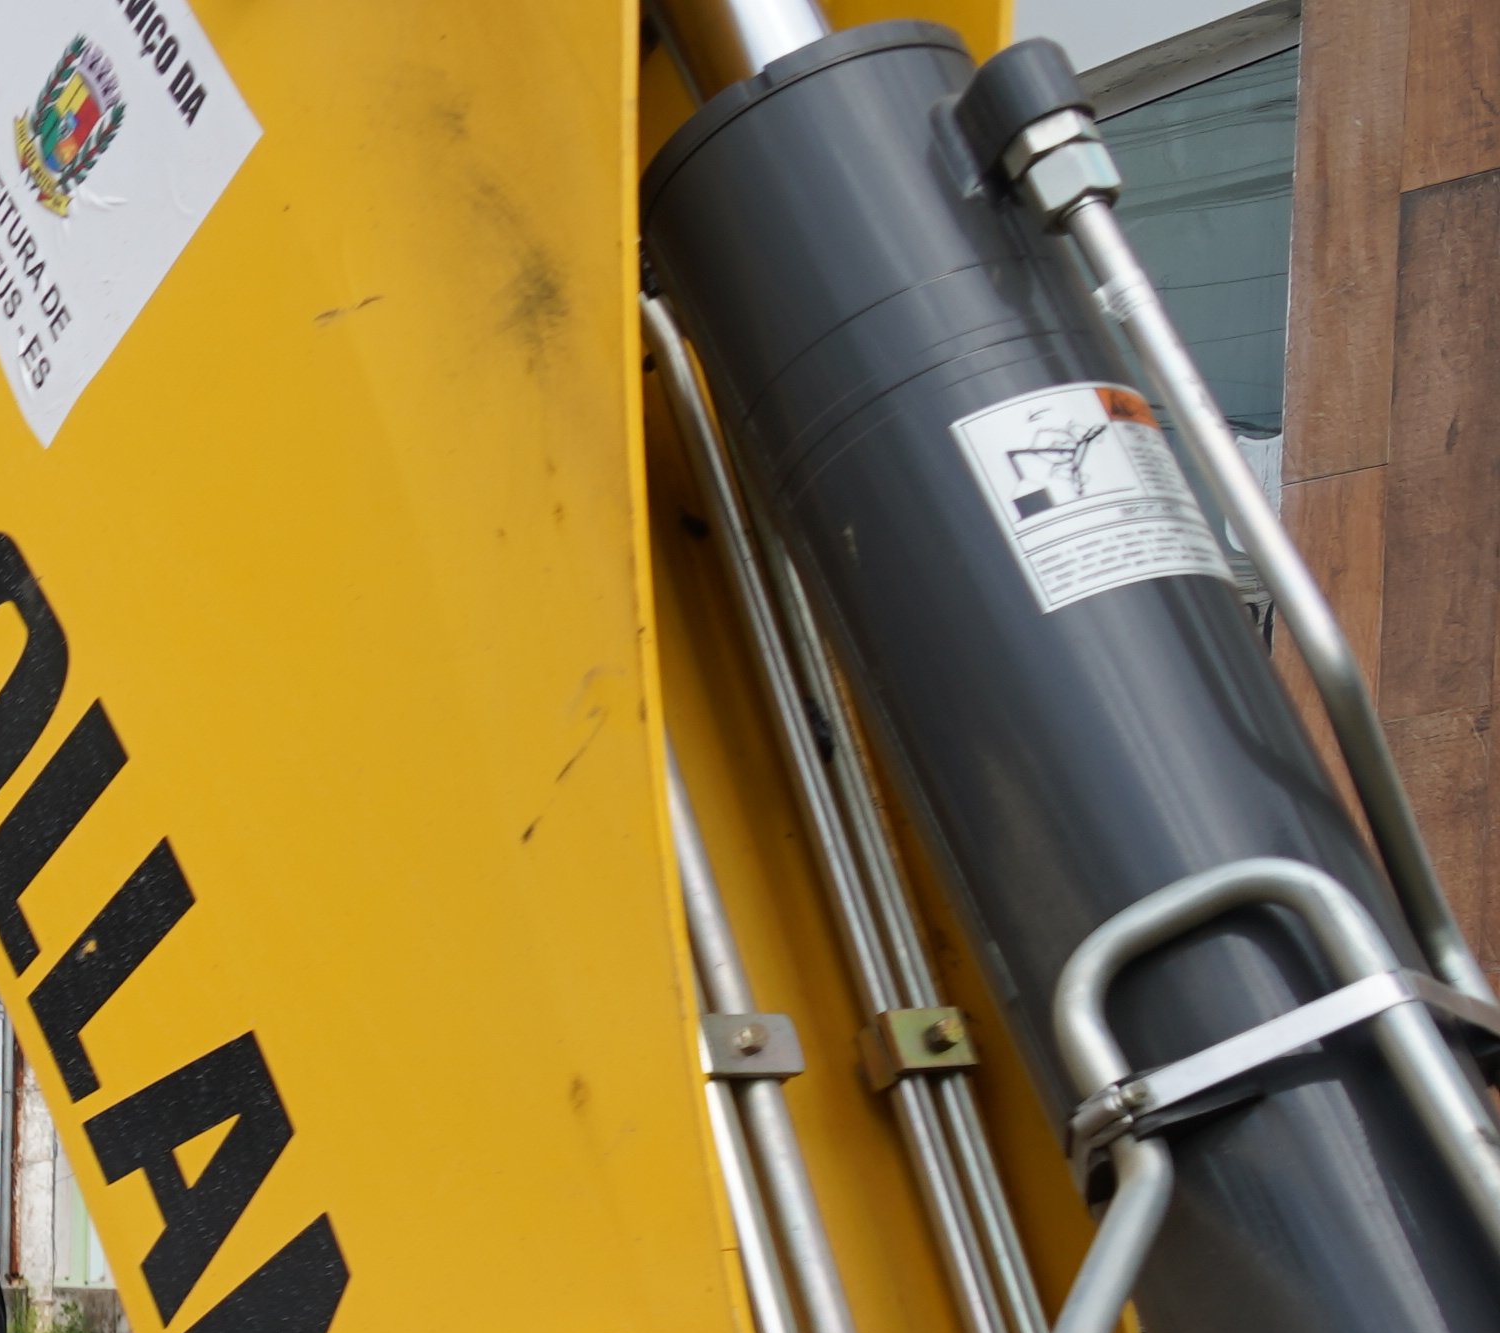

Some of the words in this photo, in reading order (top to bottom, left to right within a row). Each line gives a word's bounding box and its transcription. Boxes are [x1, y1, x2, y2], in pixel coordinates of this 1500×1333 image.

[167, 59, 208, 128] DA
[40, 283, 72, 343] DE
[19, 333, 52, 390] ES
